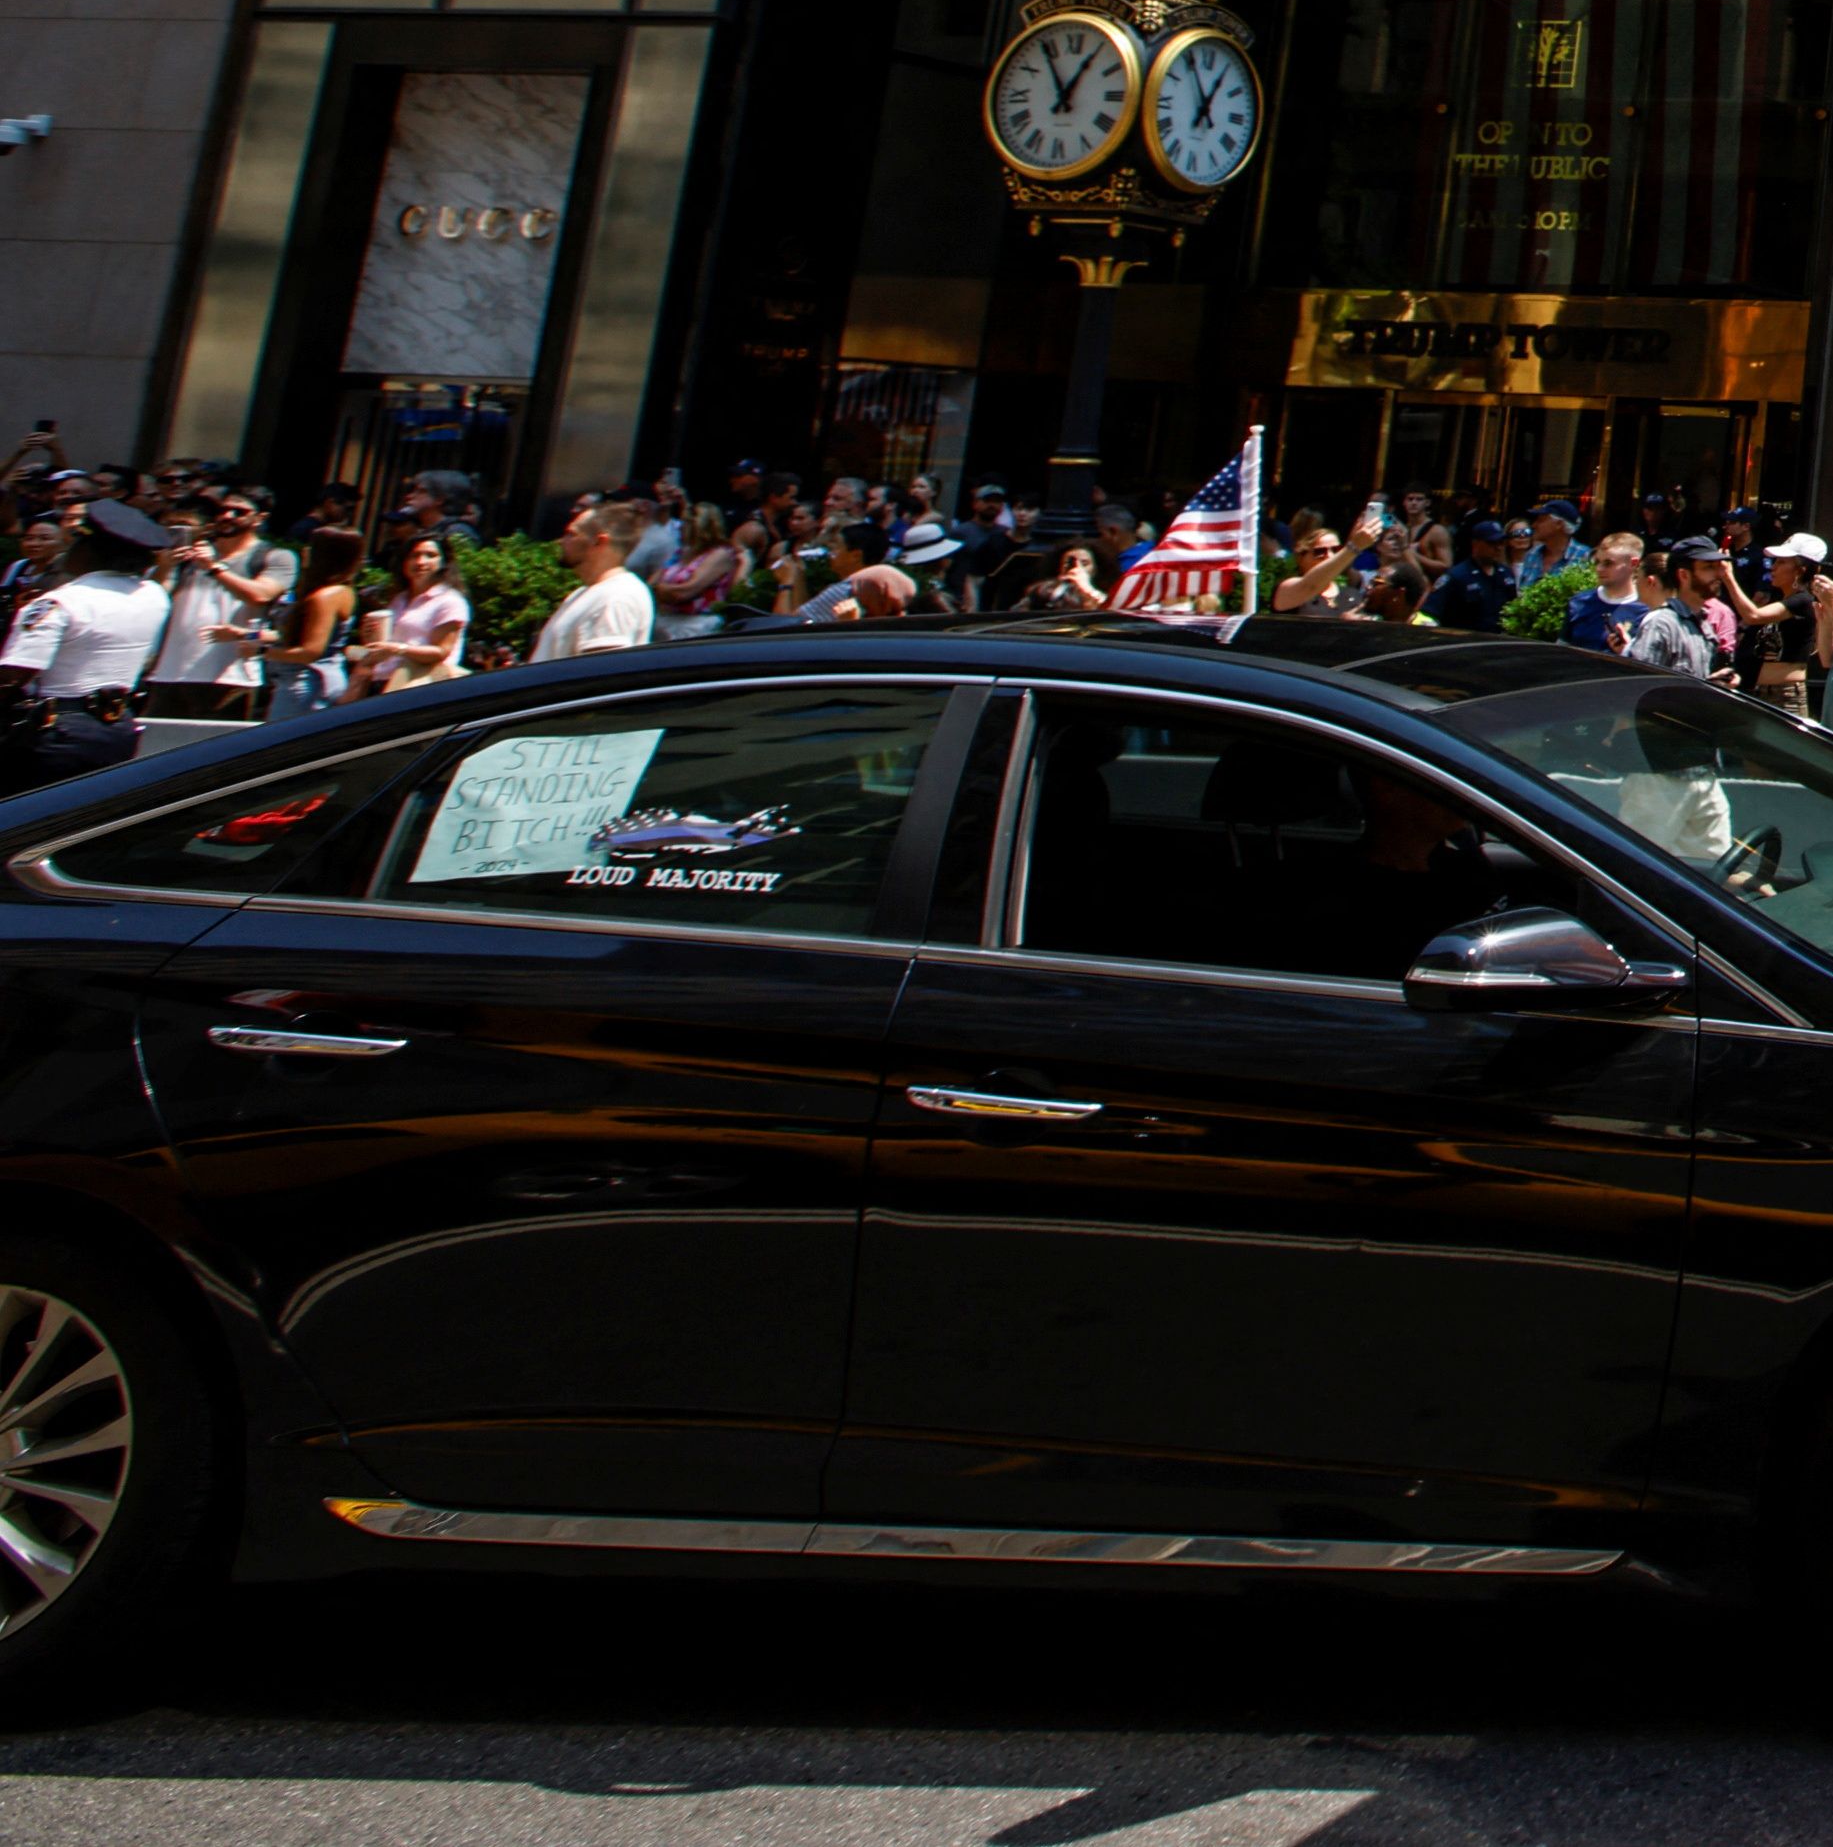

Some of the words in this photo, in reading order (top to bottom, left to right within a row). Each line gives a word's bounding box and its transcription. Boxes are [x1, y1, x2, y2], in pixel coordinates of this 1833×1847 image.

[1555, 121, 1593, 147] TO
[1346, 319, 1501, 359] TRUMP
[445, 766, 627, 811] STANDING
[566, 865, 638, 887] LOUD
[645, 867, 782, 893] MAJORITY
